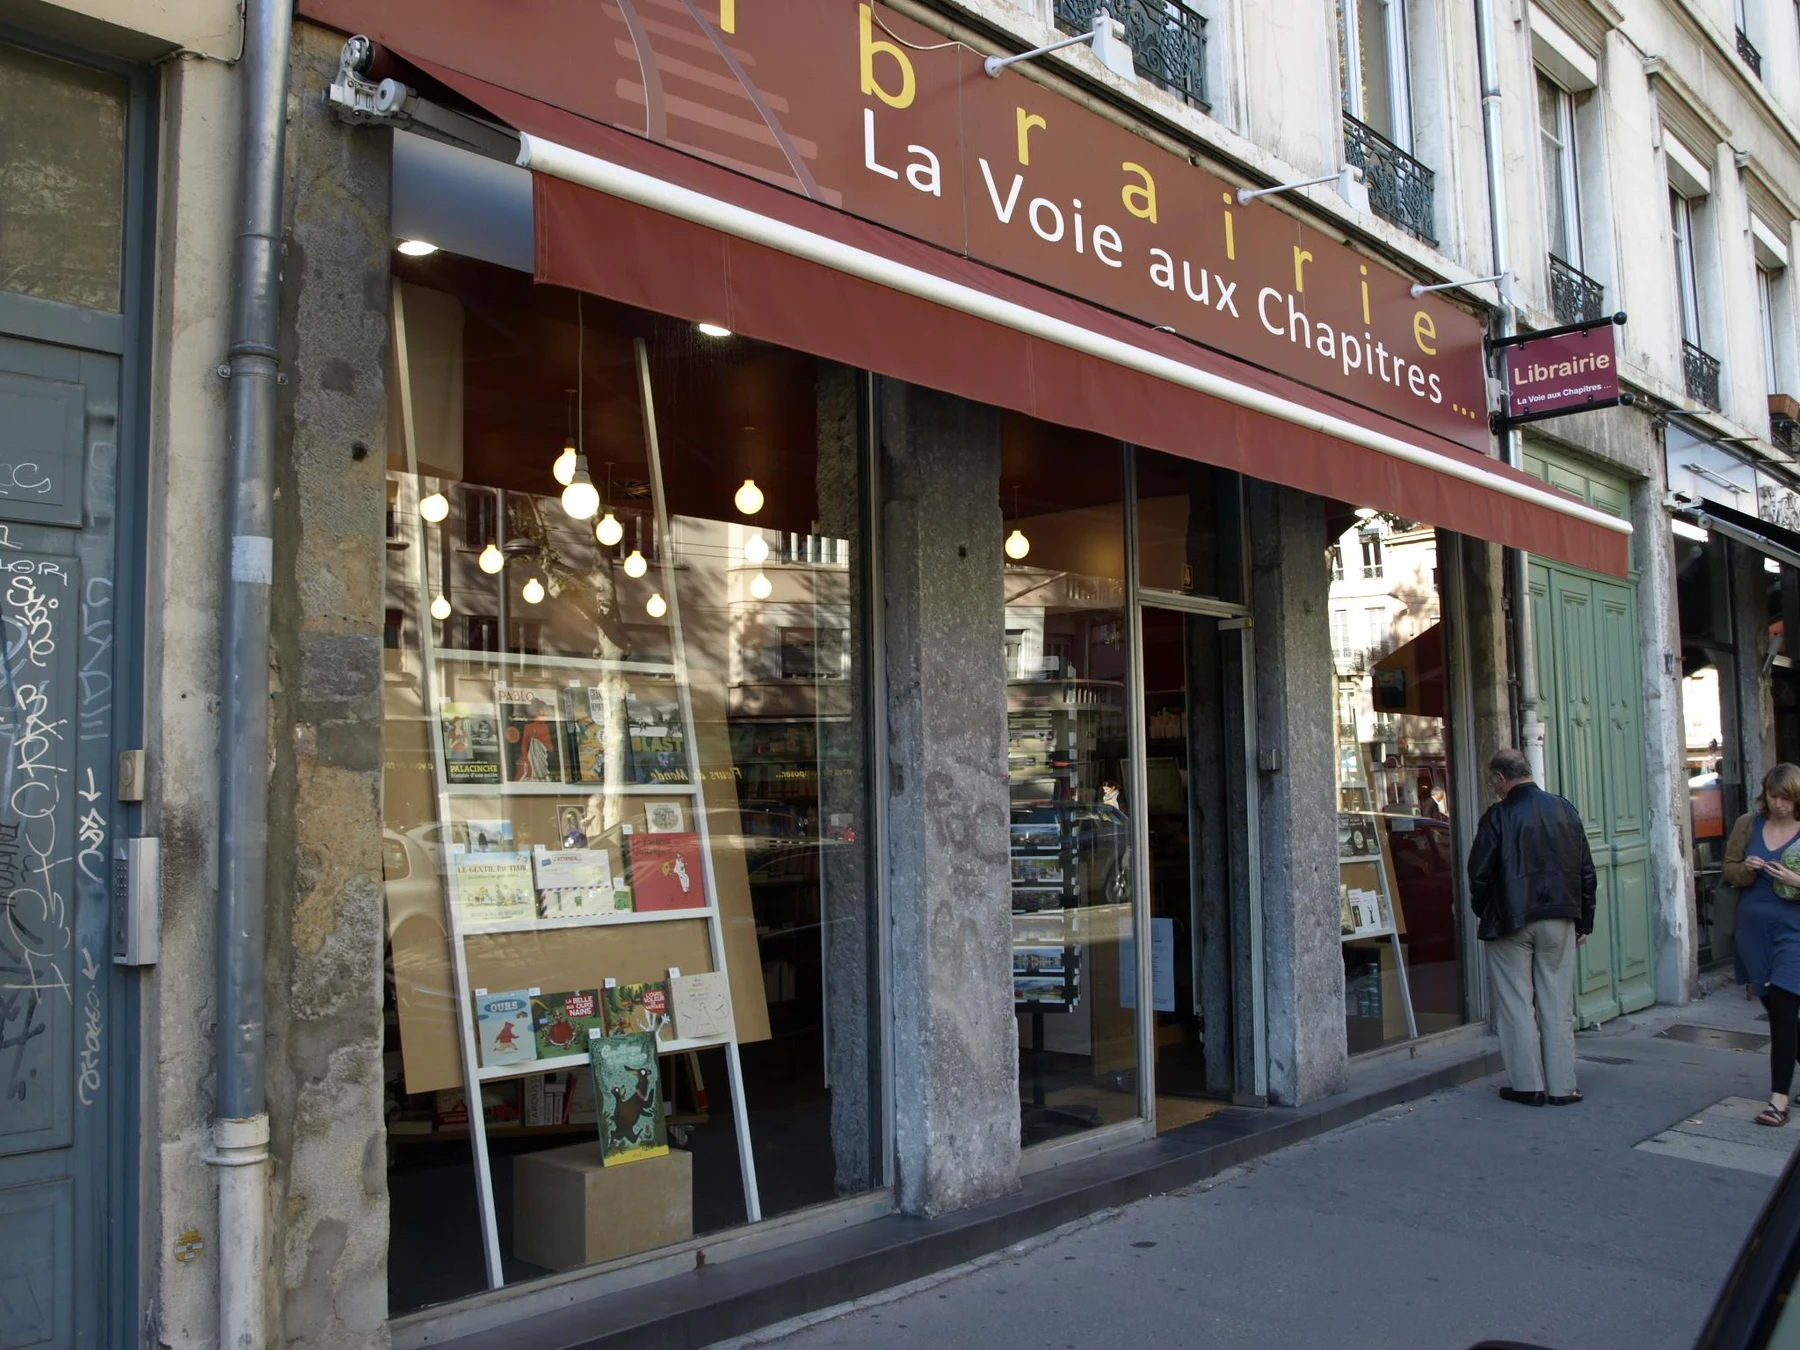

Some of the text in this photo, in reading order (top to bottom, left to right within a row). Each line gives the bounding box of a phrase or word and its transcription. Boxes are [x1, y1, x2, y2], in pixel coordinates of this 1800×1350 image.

[863, 108, 942, 197] La
[978, 158, 1123, 268] Voie
[1148, 246, 1240, 319] aux
[1257, 286, 1443, 405] Chapitres
[1513, 352, 1610, 386] Librairie
[1517, 397, 1527, 405] La
[1528, 393, 1546, 404] Voie
[1547, 392, 1562, 400] aux
[1562, 383, 1602, 397] Chapitres
[498, 690, 534, 702] PABLO
[450, 765, 498, 773] PALACINCHE
[457, 864, 527, 874] LE GENTIL FATEUR
[572, 995, 593, 1003] BELLE
[490, 1001, 518, 1012] OURS
[569, 1008, 592, 1017] NAINS
